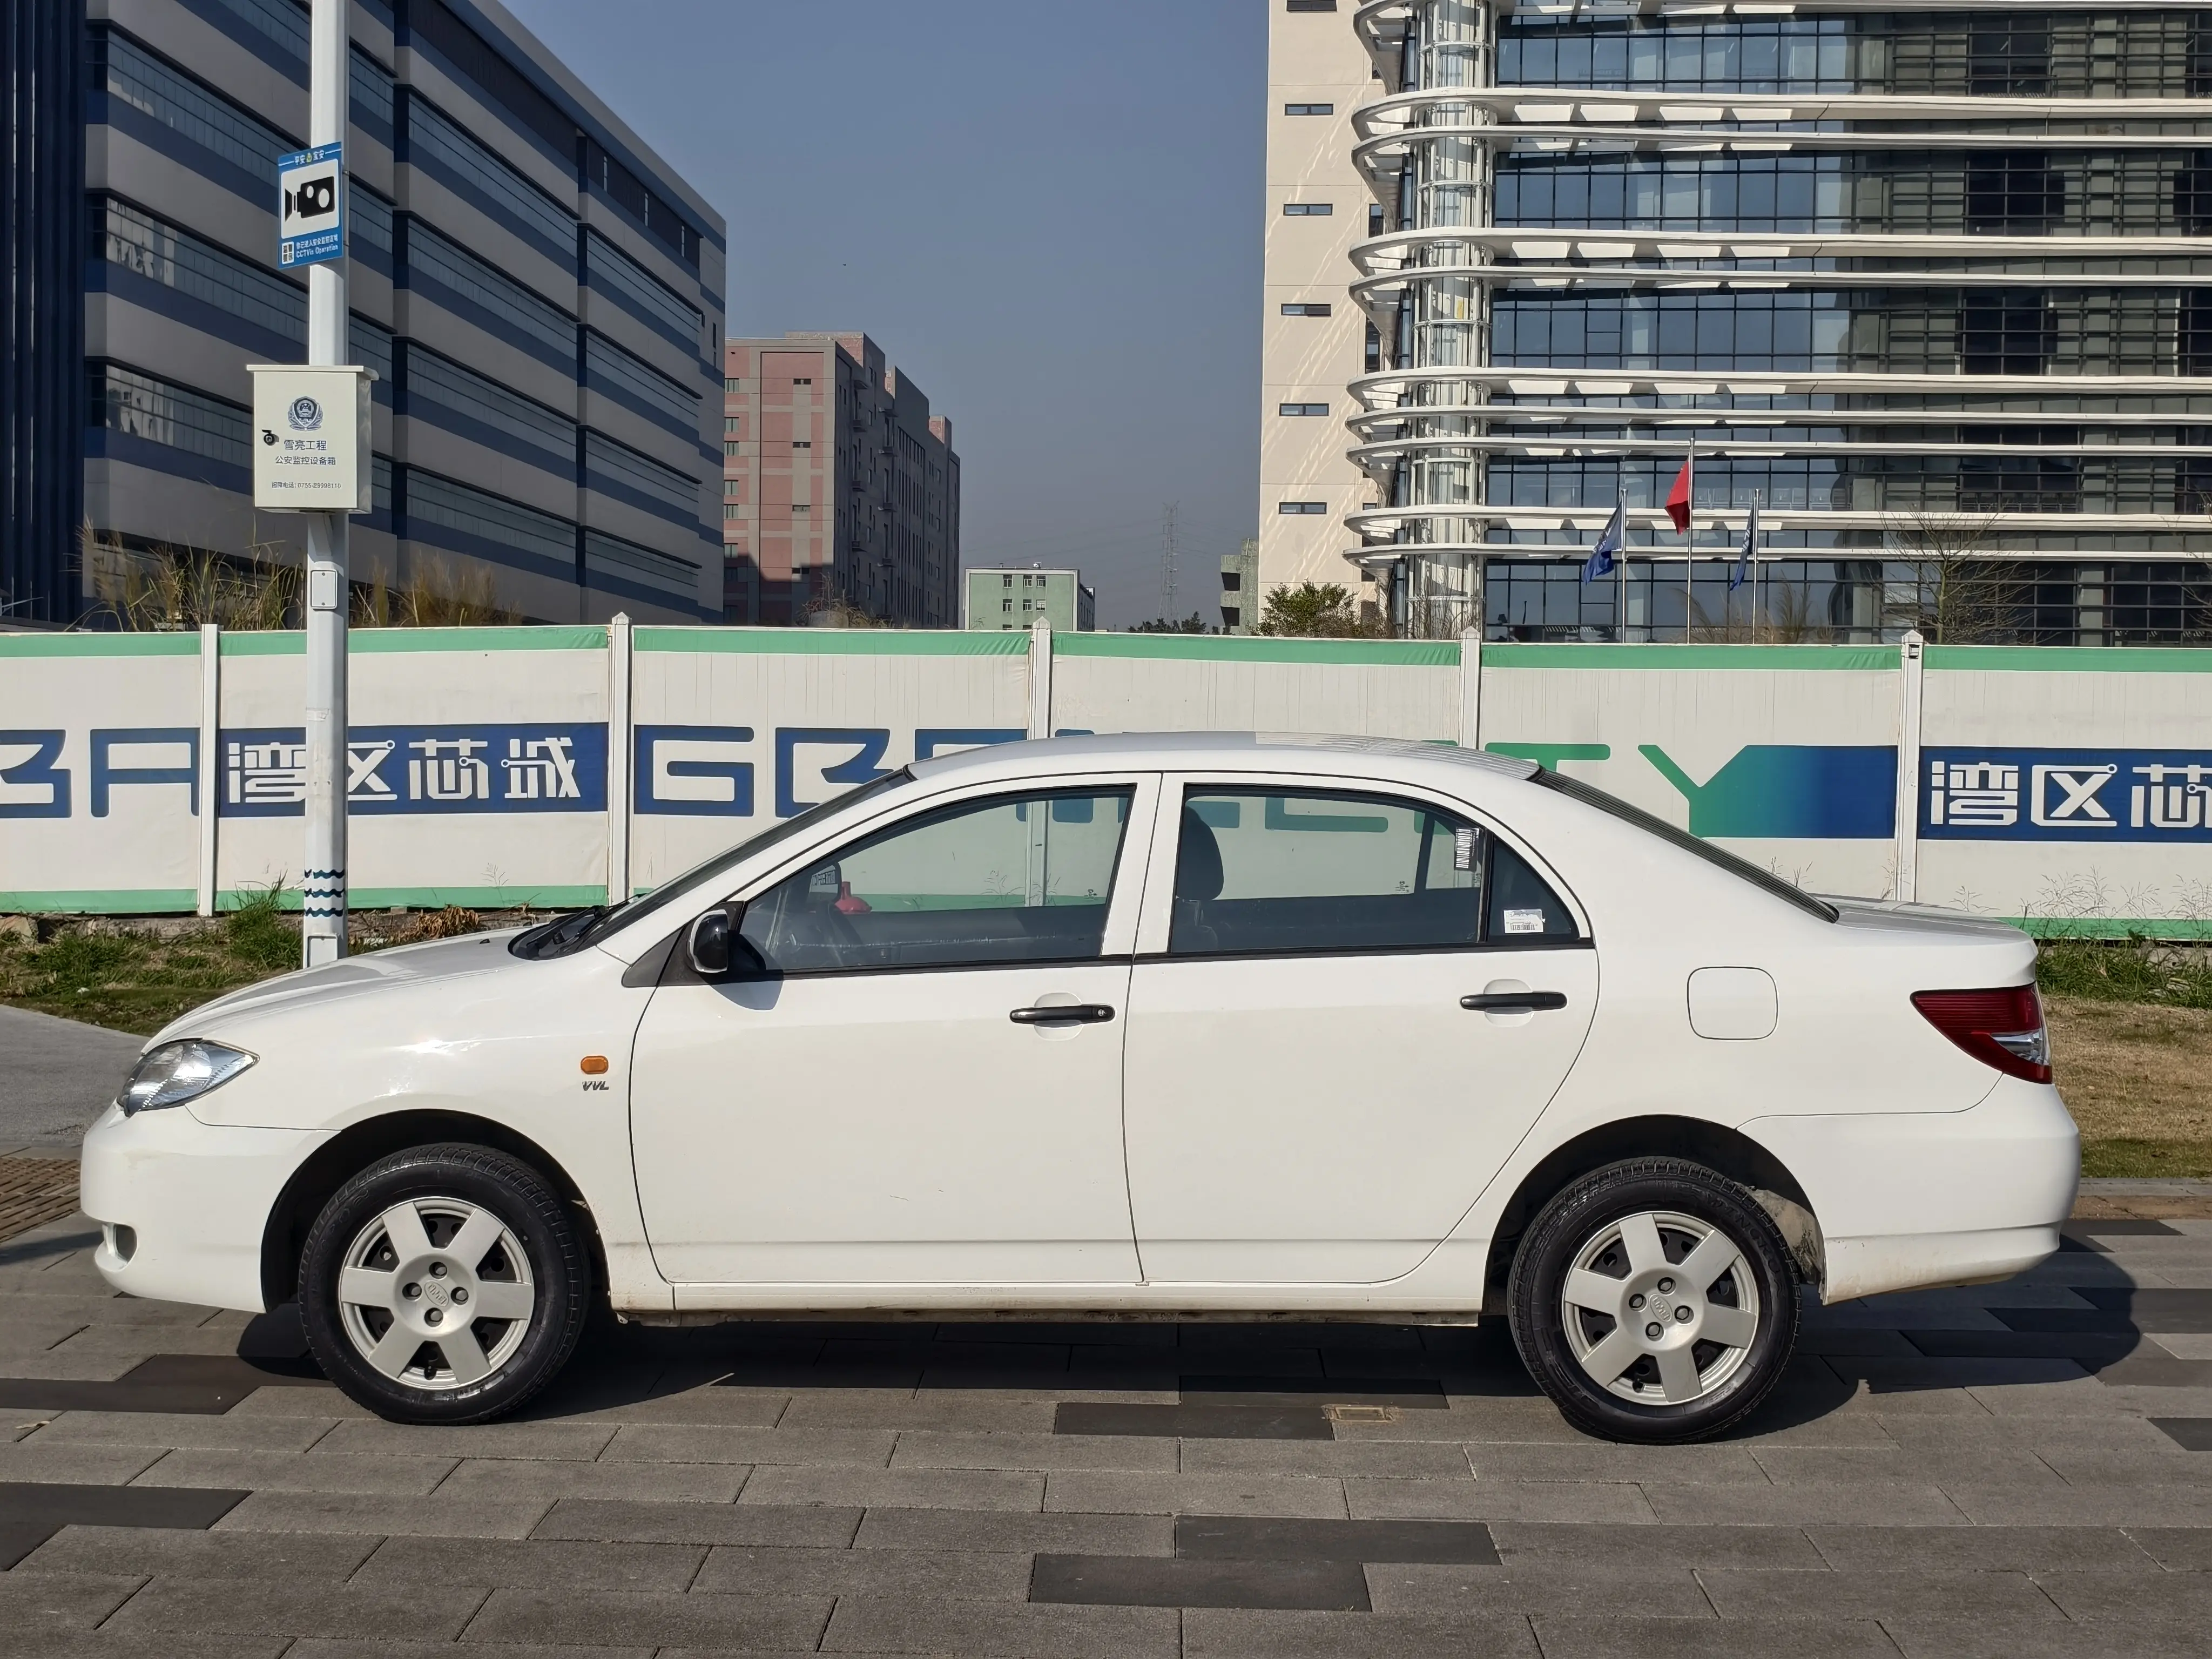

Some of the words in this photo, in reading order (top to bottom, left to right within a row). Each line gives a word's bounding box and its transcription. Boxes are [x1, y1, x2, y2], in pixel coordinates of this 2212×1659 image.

[284, 440, 327, 451] 雪亮工程
[275, 456, 336, 466] 公安监控设备箱
[228, 737, 581, 804] 湾区芯城
